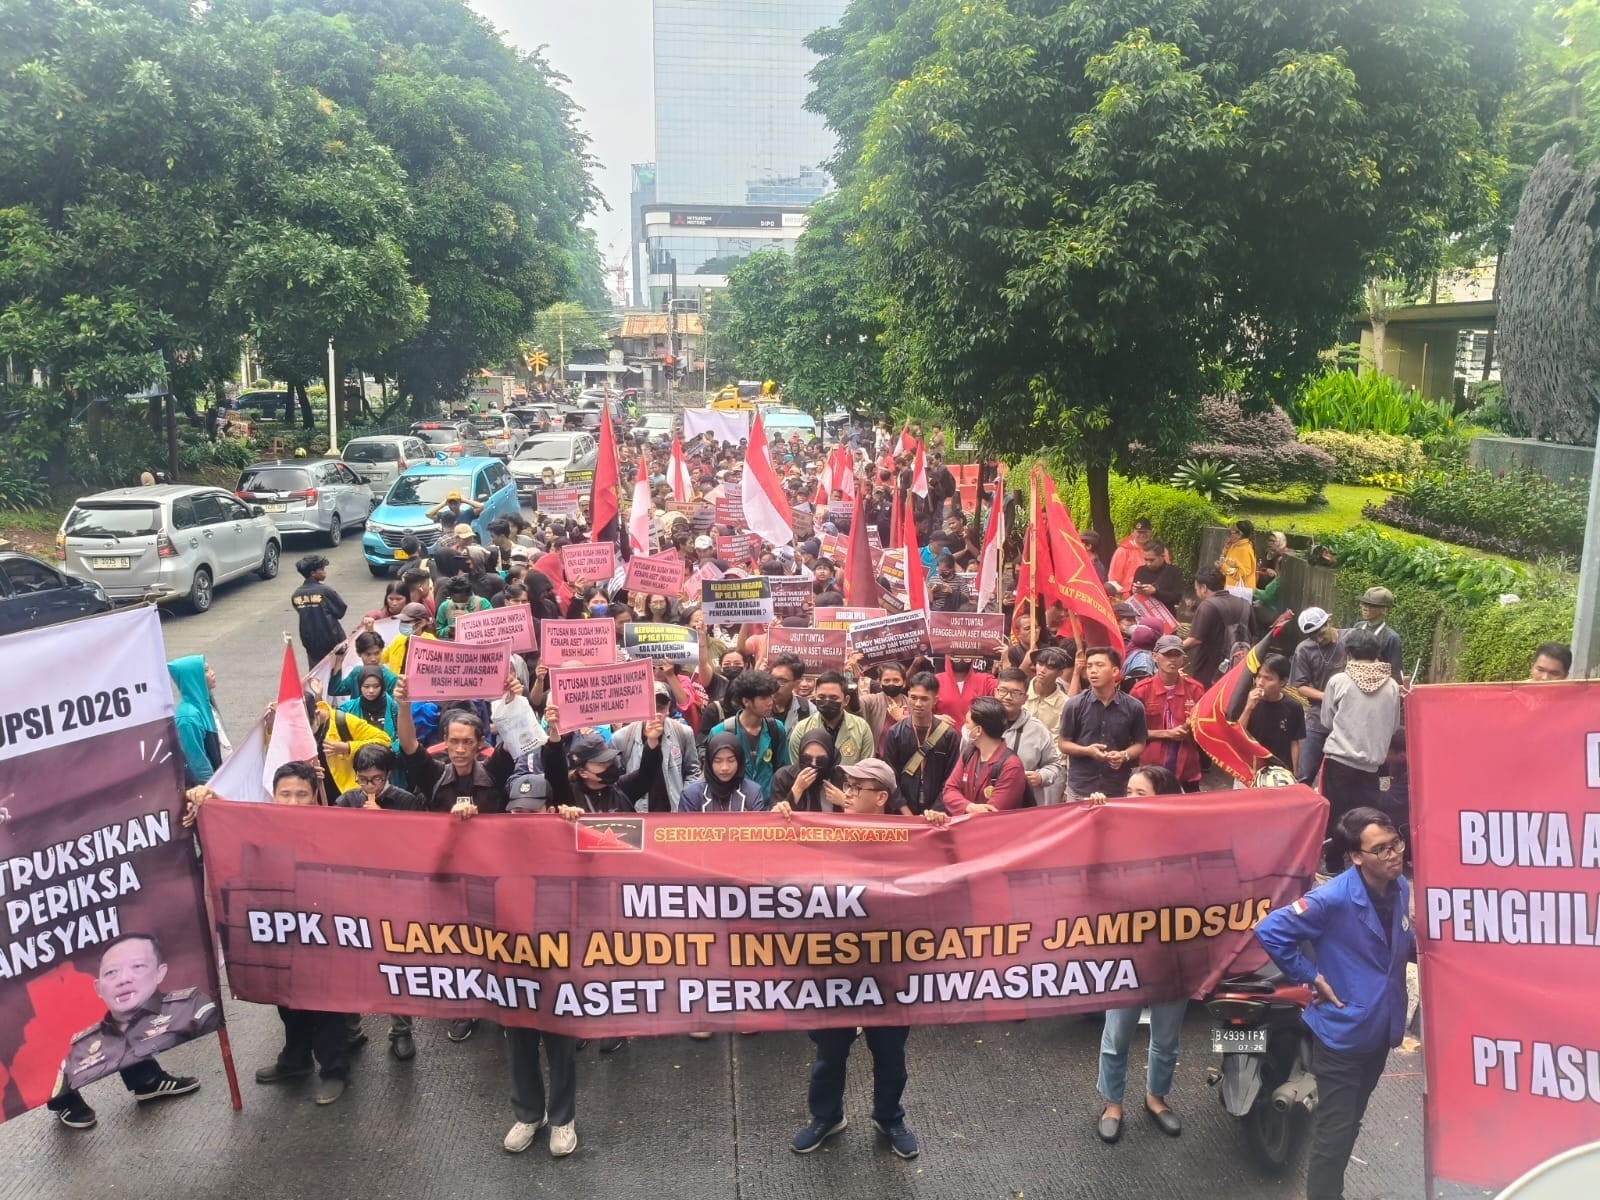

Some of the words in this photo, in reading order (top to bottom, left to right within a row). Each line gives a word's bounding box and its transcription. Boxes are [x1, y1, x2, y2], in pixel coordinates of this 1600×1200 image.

[415, 647, 443, 662] PUTUSAN
[444, 652, 454, 662] MA
[455, 652, 478, 663] SUDAH
[479, 652, 504, 662] INKRAH
[416, 663, 442, 674] KENAPA
[444, 664, 460, 675] ASET
[462, 664, 498, 675] JIWASRAYA
[431, 676, 452, 687] MASIH
[453, 677, 477, 687] HILANG
[558, 678, 589, 690] PUTUSAN
[590, 676, 600, 688] MA
[600, 673, 622, 687] SUDAH
[623, 668, 647, 684] INKRAH
[58, 686, 132, 732] 2026
[564, 690, 590, 705] KENAPA
[591, 688, 607, 700] ASET
[608, 684, 643, 698] JIWASRAYA
[579, 703, 600, 714] MASIH
[600, 700, 625, 713] HILANG
[654, 827, 726, 843] SERIKAT
[729, 827, 798, 842] PEMUDA
[799, 827, 910, 843] KERAKYATAN
[1459, 810, 1575, 869] BUKA
[5, 860, 142, 935] PERIKSA
[622, 883, 869, 920] MENDESAK
[1425, 887, 1600, 947] PENGHIL
[248, 911, 328, 946] BPK
[333, 915, 373, 950] RI
[380, 919, 570, 969] LAKUKAN
[583, 930, 716, 968] AUDIT
[729, 922, 1032, 968] INVESTIGATIF
[379, 963, 541, 1010] TERKAIT
[553, 979, 665, 1018] ASET
[678, 976, 885, 1013] PERKARA
[895, 958, 1140, 1005] JIWASRAYA
[1223, 1030, 1245, 1040] 4939
[1472, 1035, 1523, 1092] PT
